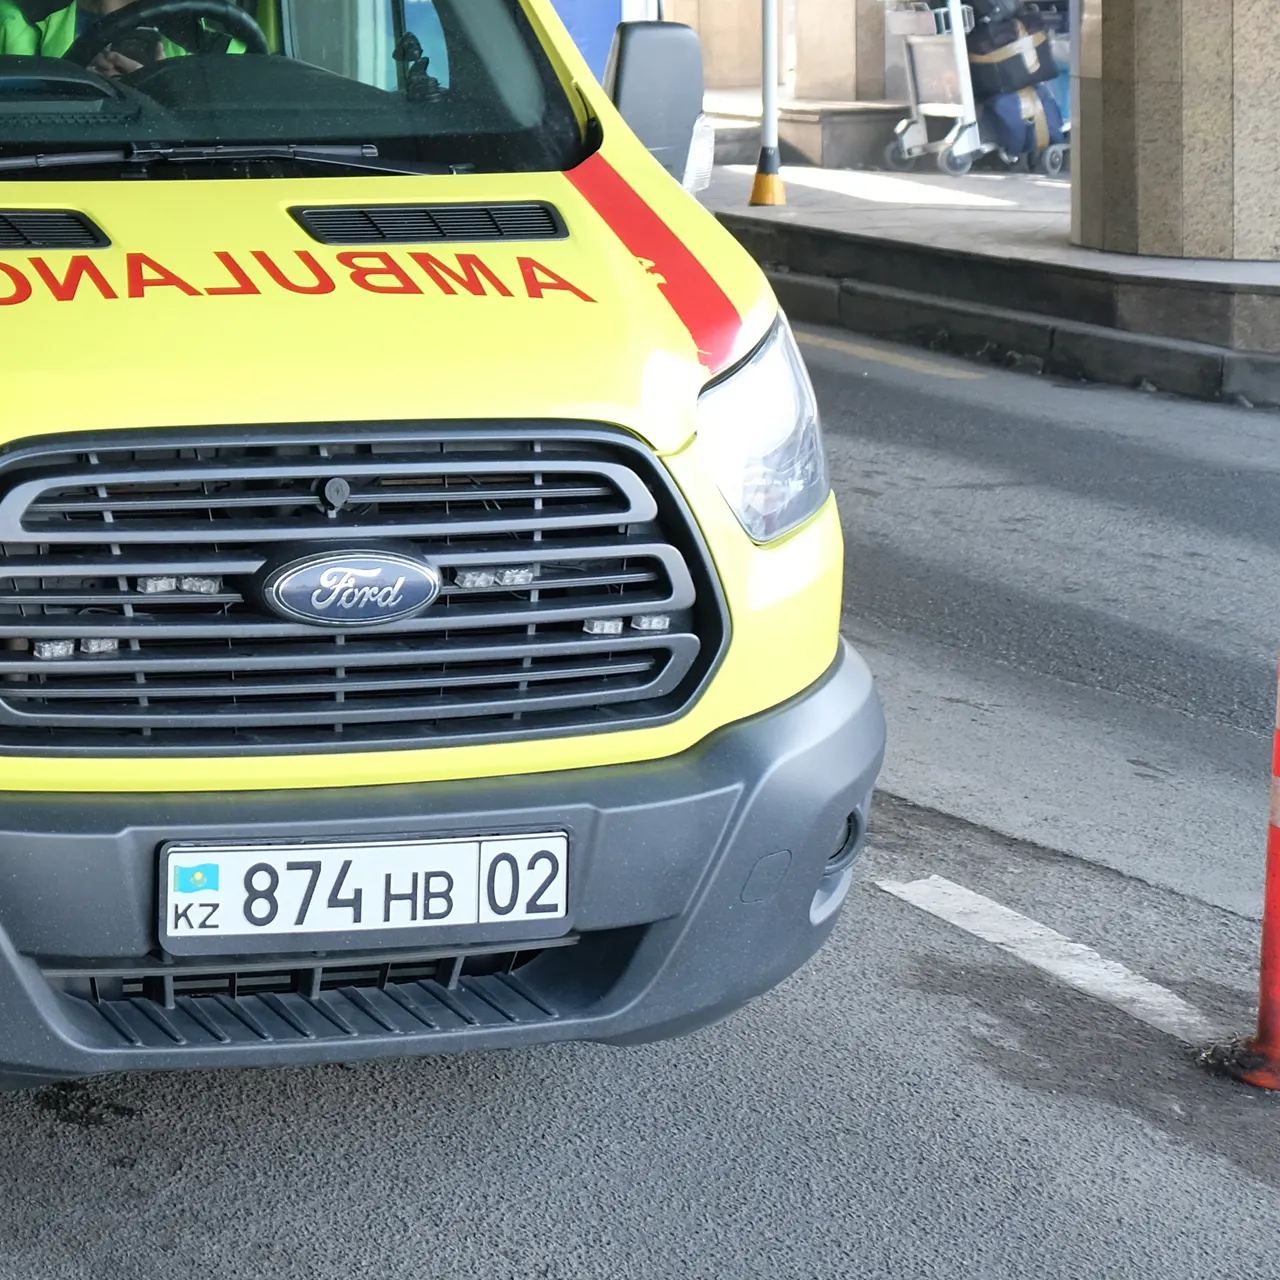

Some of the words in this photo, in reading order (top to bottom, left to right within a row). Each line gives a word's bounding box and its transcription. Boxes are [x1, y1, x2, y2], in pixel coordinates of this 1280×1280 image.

[309, 565, 406, 611] Ford
[172, 901, 221, 930] KZ
[242, 859, 364, 927] 874
[382, 870, 456, 924] HB
[486, 850, 561, 917] 02
